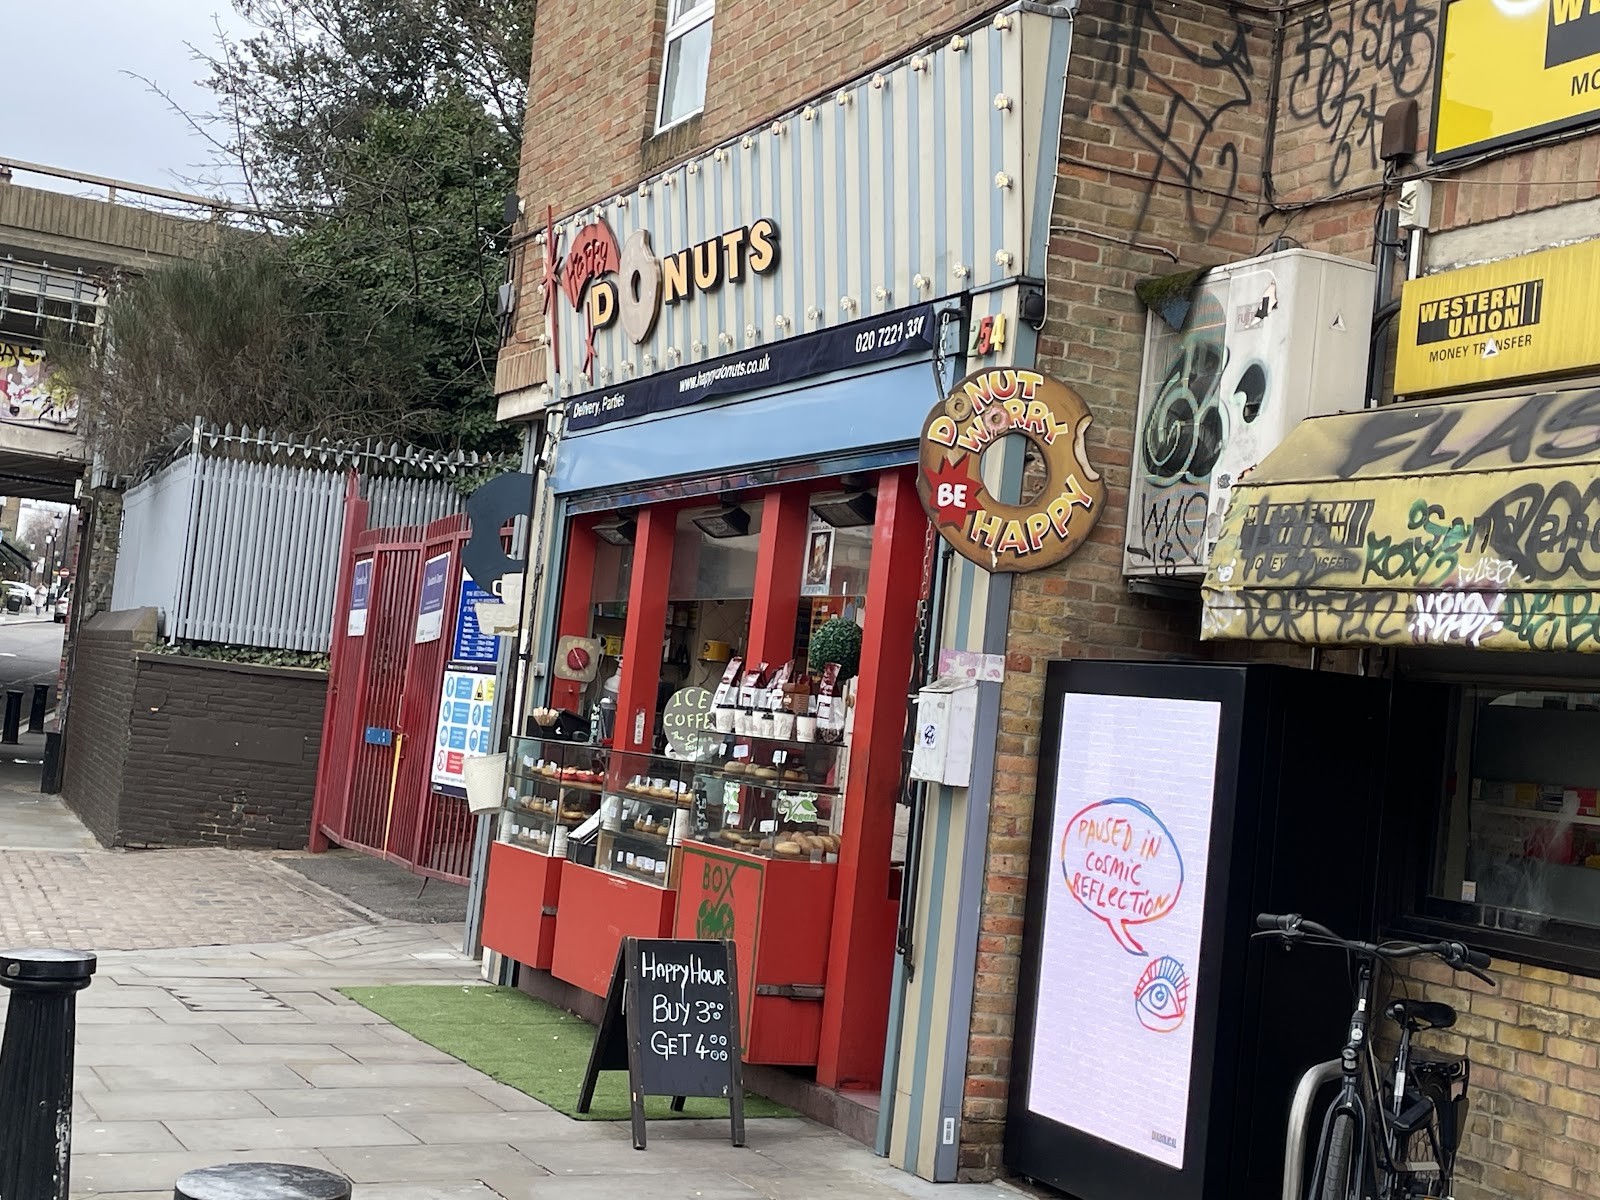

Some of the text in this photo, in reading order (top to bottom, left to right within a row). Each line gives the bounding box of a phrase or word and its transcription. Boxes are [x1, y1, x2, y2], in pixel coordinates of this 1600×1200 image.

[1420, 284, 1522, 323] WESTERN
[855, 330, 876, 353] 020
[877, 321, 903, 348] 7221
[1448, 306, 1520, 338] UNION
[1429, 334, 1532, 363] MONEY TRNSFER
[927, 369, 1044, 447] DONUT
[957, 398, 1069, 453] WORRY
[937, 483, 968, 509] BE
[970, 474, 1093, 554] HAPPY
[673, 689, 711, 709] ICE
[1077, 817, 1133, 852] PAUSED
[703, 862, 741, 899] BOX
[696, 1000, 711, 1023] 3
[650, 1030, 711, 1061] GET 4
